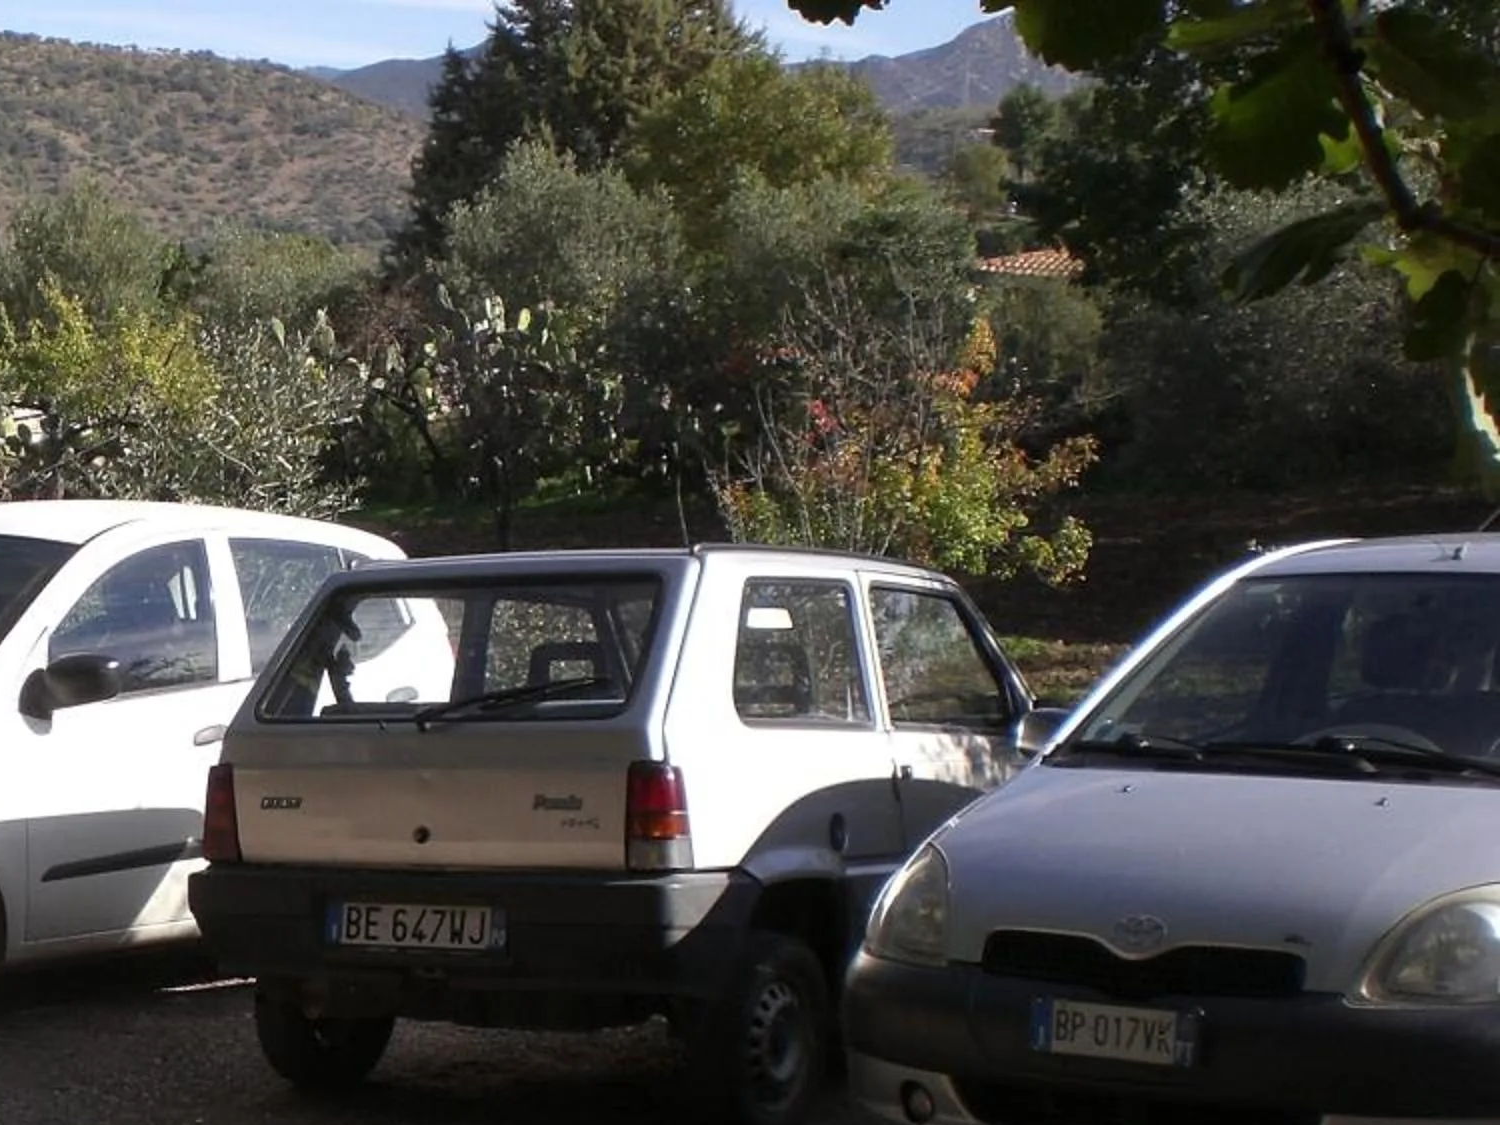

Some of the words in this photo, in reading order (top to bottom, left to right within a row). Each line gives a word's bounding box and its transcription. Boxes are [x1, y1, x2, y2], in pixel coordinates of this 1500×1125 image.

[345, 906, 382, 941] BE
[391, 909, 486, 945] 647WJ
[1055, 1009, 1085, 1042] BP
[1094, 1013, 1172, 1056] 017VK
